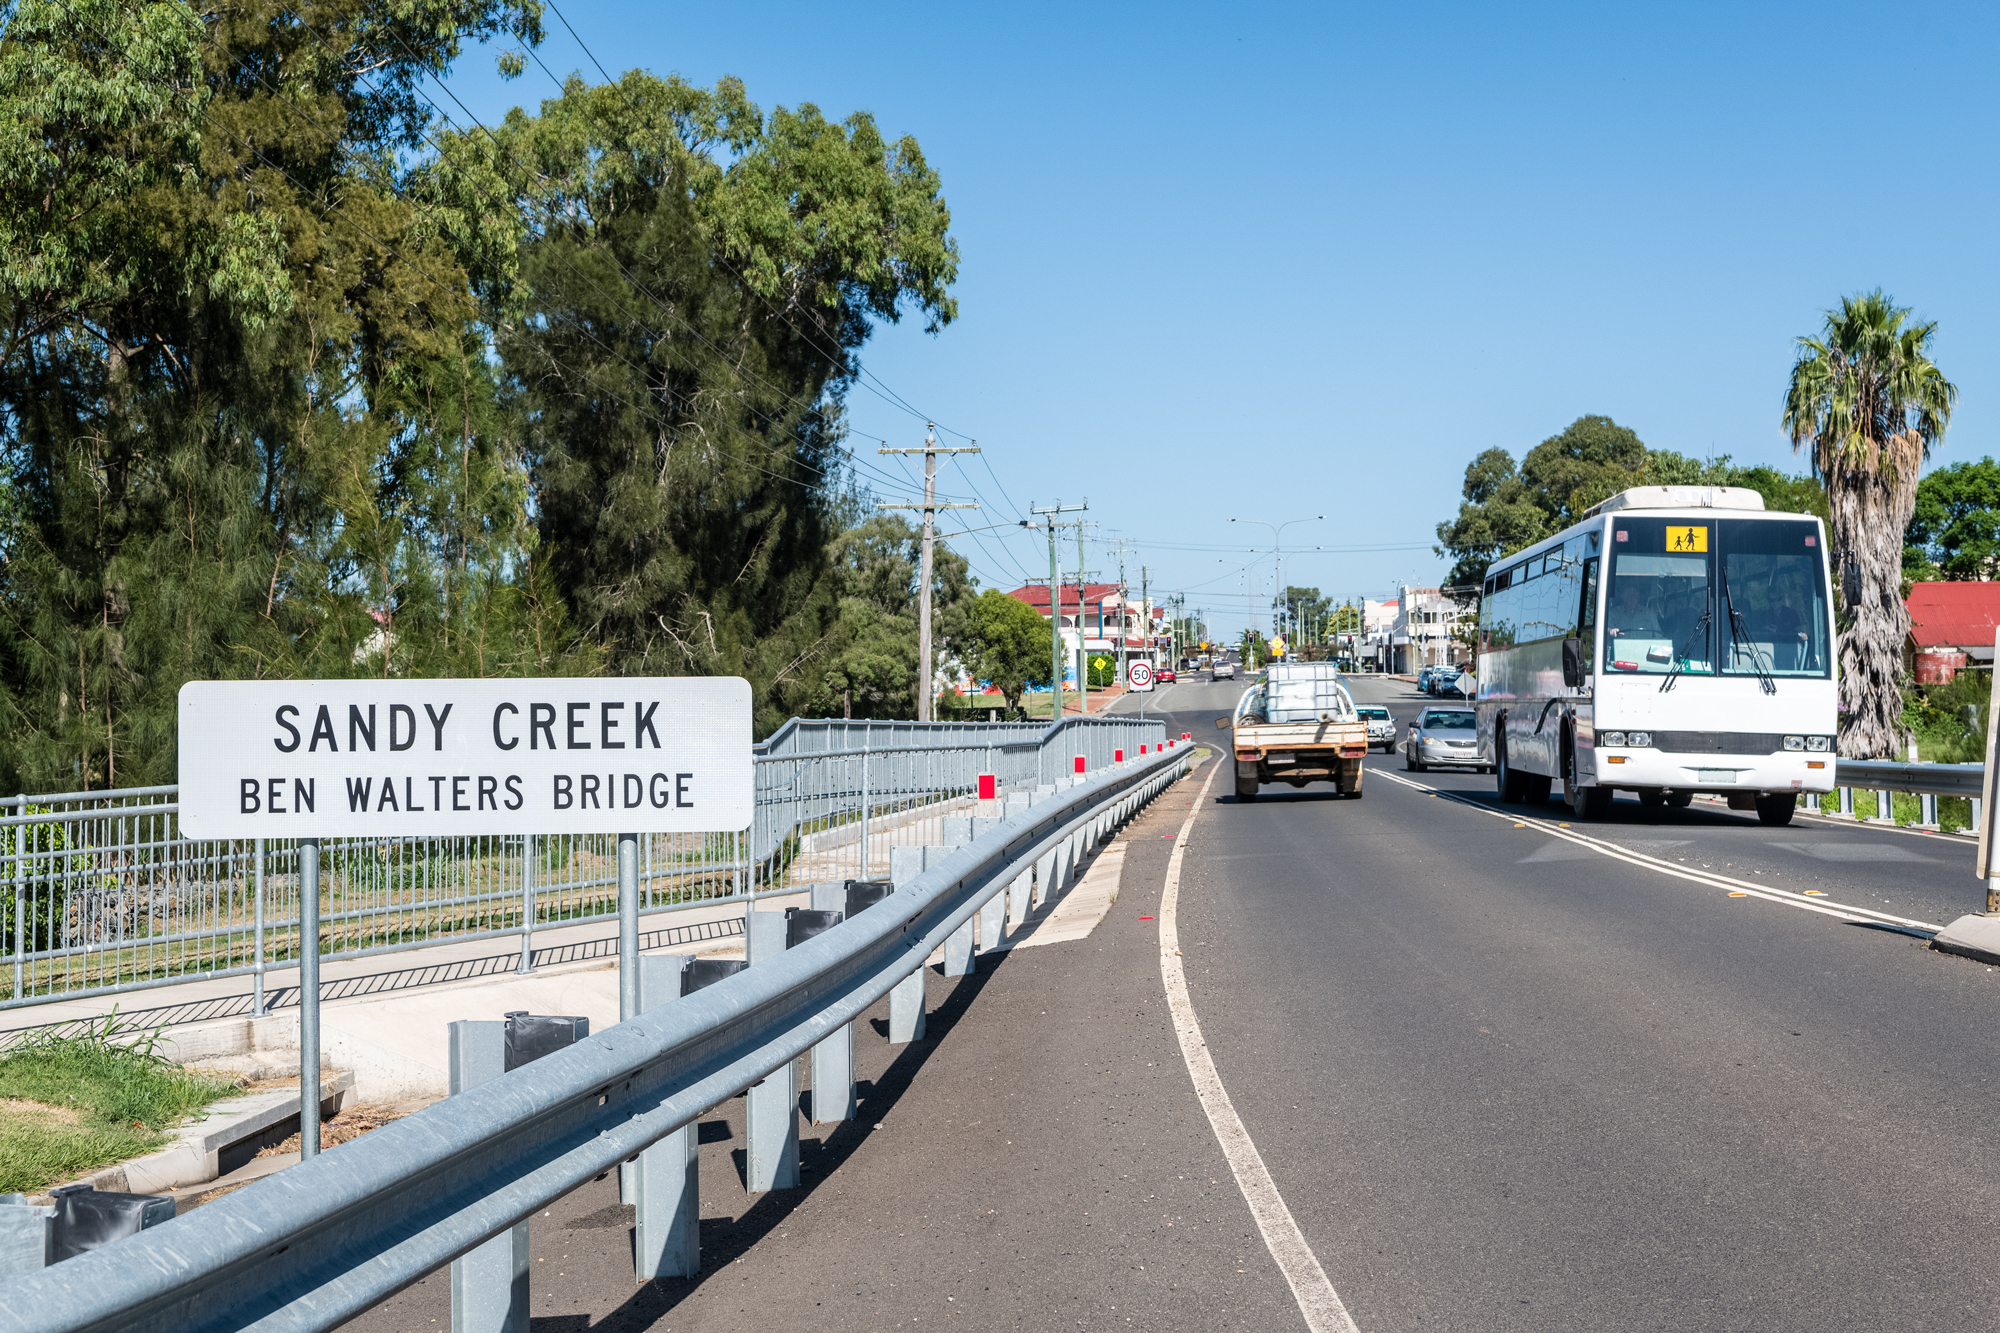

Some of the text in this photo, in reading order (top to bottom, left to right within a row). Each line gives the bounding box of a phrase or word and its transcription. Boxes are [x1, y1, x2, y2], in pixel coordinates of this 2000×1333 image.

[1134, 669, 1149, 680] 50
[273, 701, 662, 753] SANDY CREEK
[240, 772, 694, 814] BEN WALTERS BRIDGE
